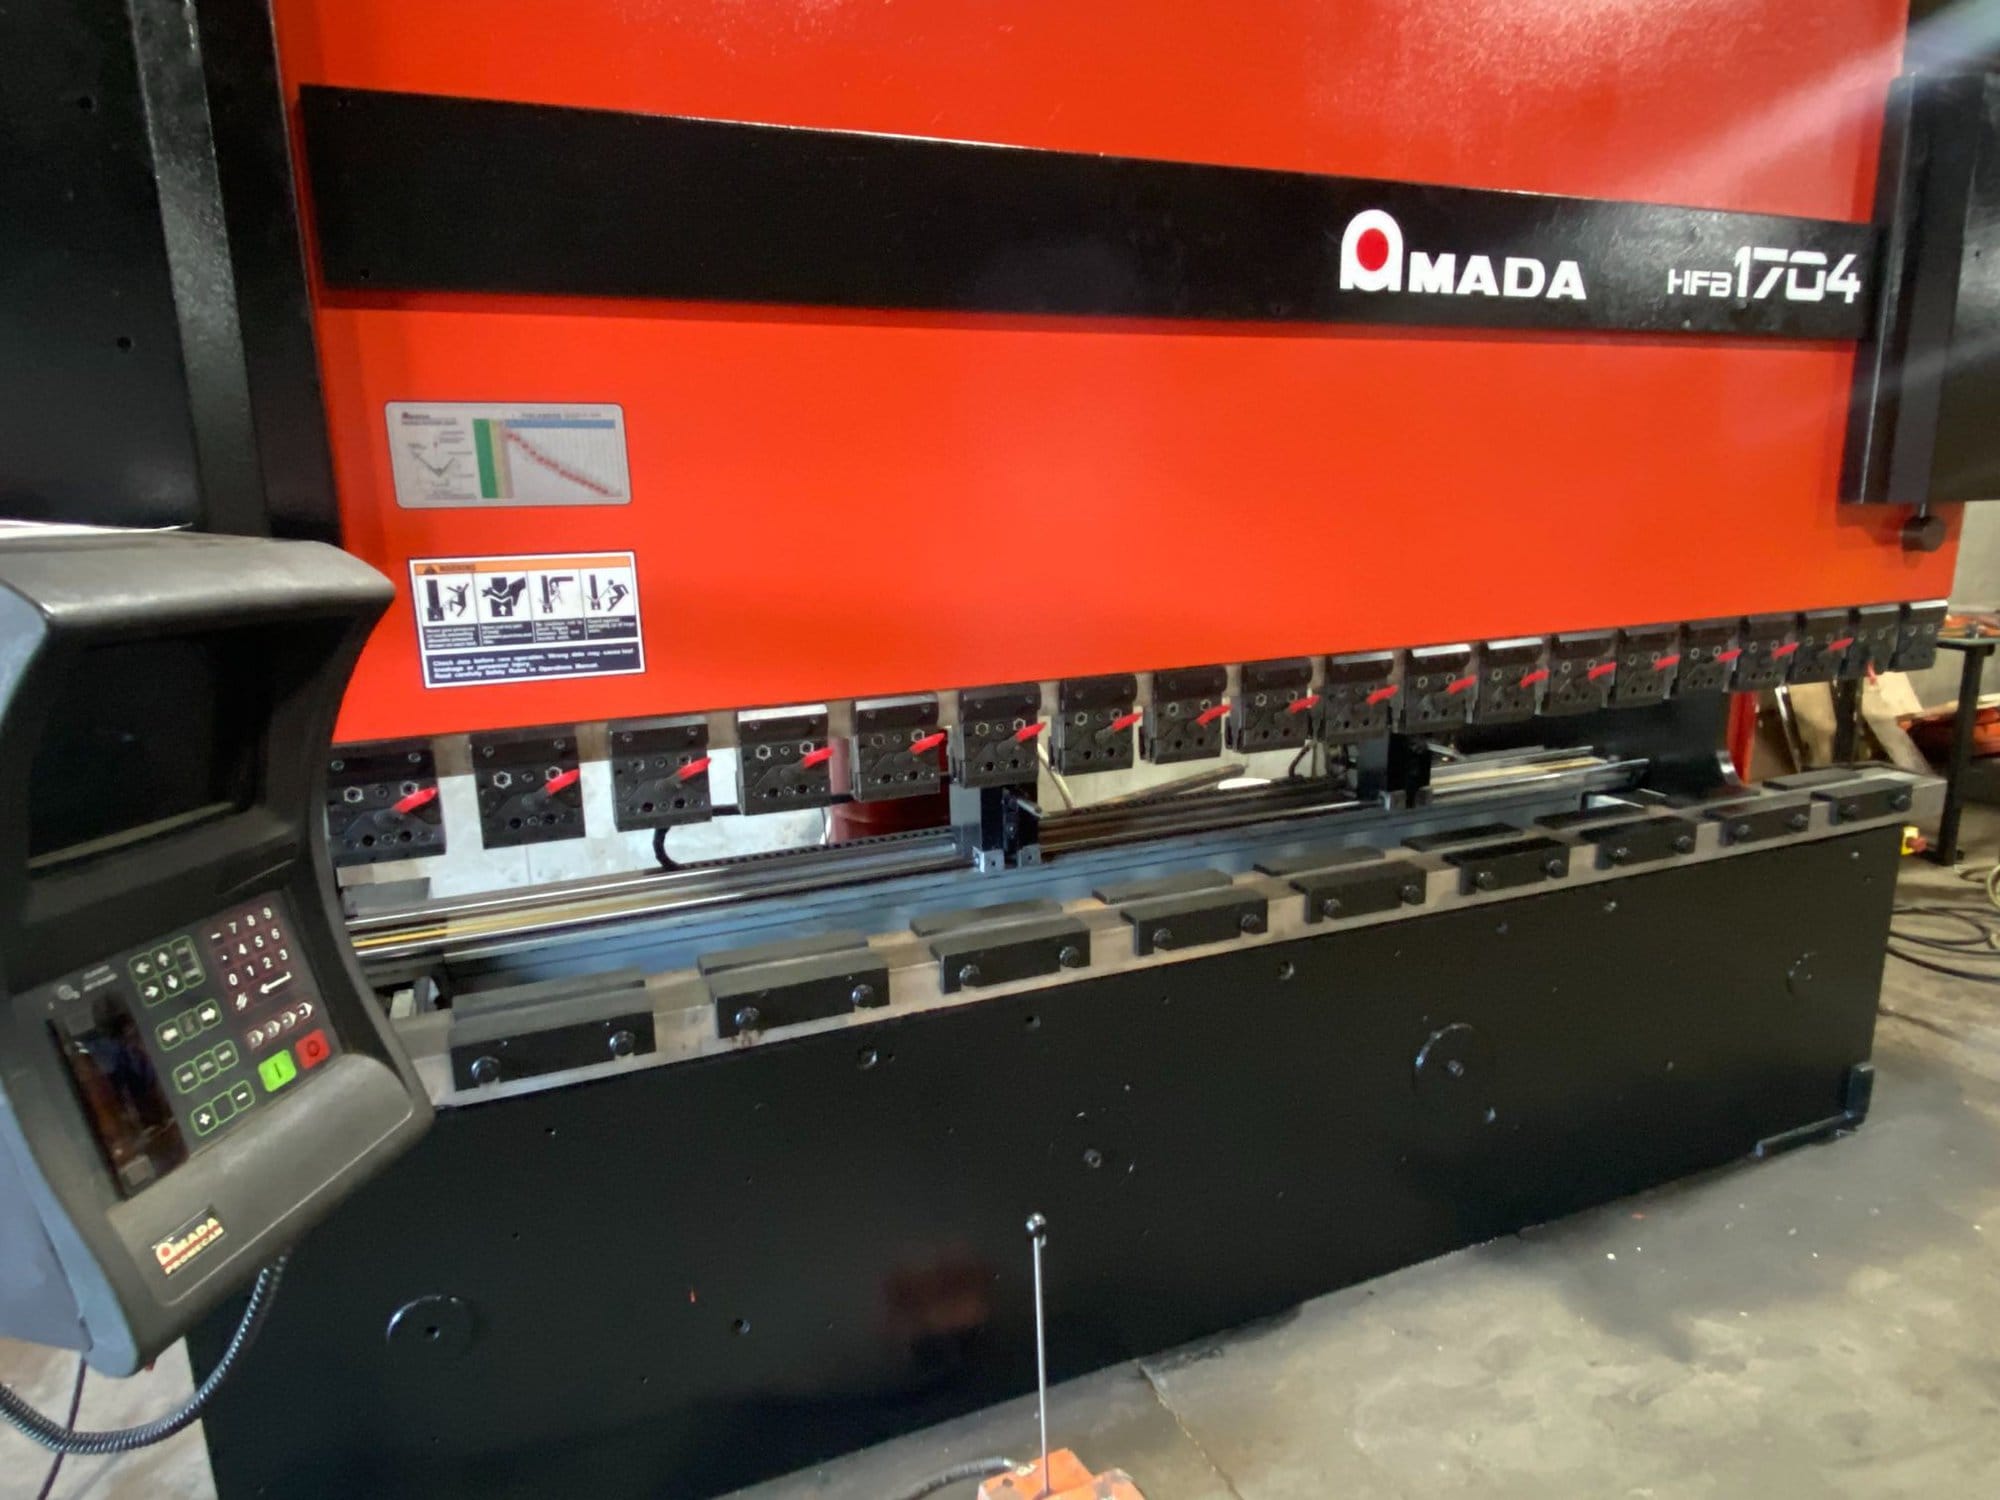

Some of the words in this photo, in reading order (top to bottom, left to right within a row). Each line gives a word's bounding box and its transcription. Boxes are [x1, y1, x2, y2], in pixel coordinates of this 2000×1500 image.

[1339, 209, 1586, 300] AMADA
[228, 922, 237, 934] 7
[247, 915, 256, 926] 8
[263, 907, 272, 919] 9
[239, 943, 247, 954] 4
[255, 935, 264, 948] 5
[271, 928, 280, 939] 6
[229, 973, 238, 985] 0
[246, 965, 254, 976] 1
[263, 957, 273, 969] 2
[279, 949, 288, 960] 3
